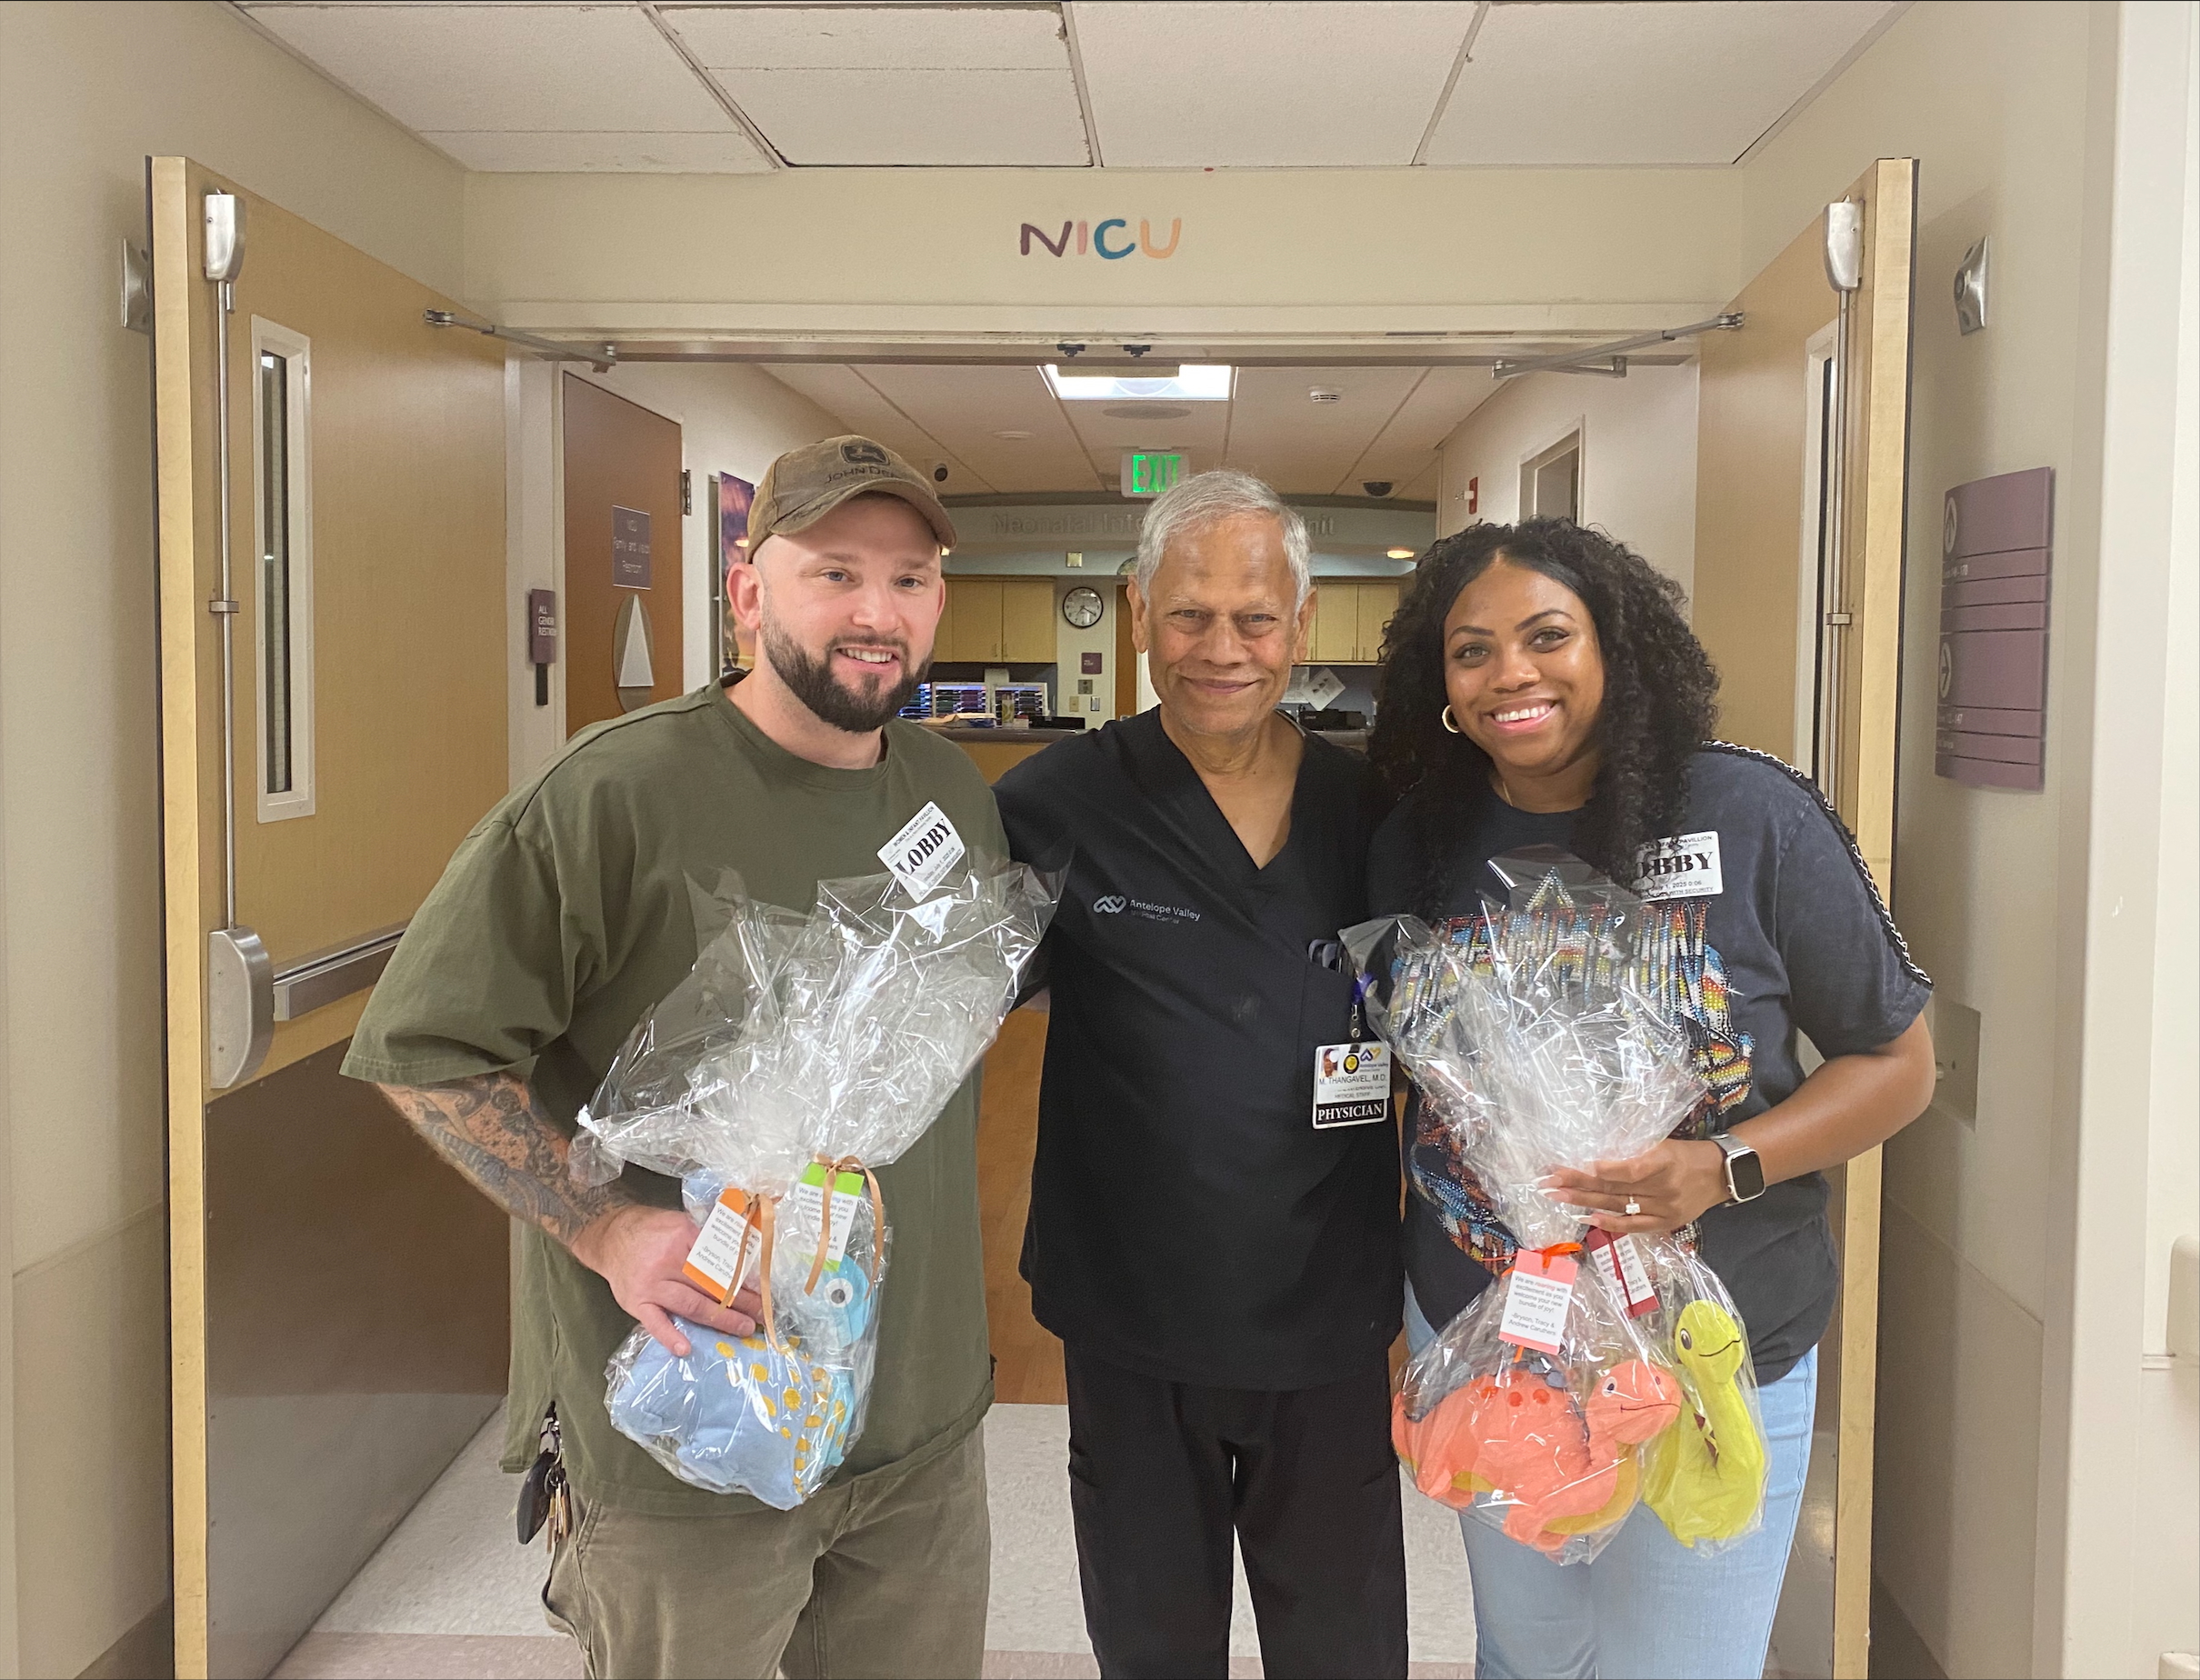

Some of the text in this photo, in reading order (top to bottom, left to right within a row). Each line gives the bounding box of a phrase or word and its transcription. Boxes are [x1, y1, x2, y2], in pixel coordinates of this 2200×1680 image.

[1020, 217, 1182, 259] NICU
[825, 467, 865, 484] JOHN
[1132, 454, 1181, 493] EXIT
[995, 513, 1093, 535] Neonatal
[1304, 514, 1335, 536] nit
[538, 605, 547, 615] ALL
[894, 818, 952, 880] LOBBY
[1130, 899, 1200, 922] Antelope Valley
[1317, 1103, 1383, 1122] PHYSICIAN
[716, 1208, 725, 1216] We
[710, 1224, 733, 1240] welcome
[715, 1217, 742, 1236] excitement
[713, 1234, 730, 1248] bundle
[696, 1251, 715, 1266] Andrew
[720, 1259, 735, 1272] Tracy
[1515, 1285, 1545, 1295] excitement
[1534, 1282, 1556, 1291] roaring
[1513, 1291, 1538, 1301] welcome
[1518, 1300, 1537, 1308] bundle
[1508, 1319, 1530, 1328] Andrew
[1534, 1318, 1550, 1327] Tracy
